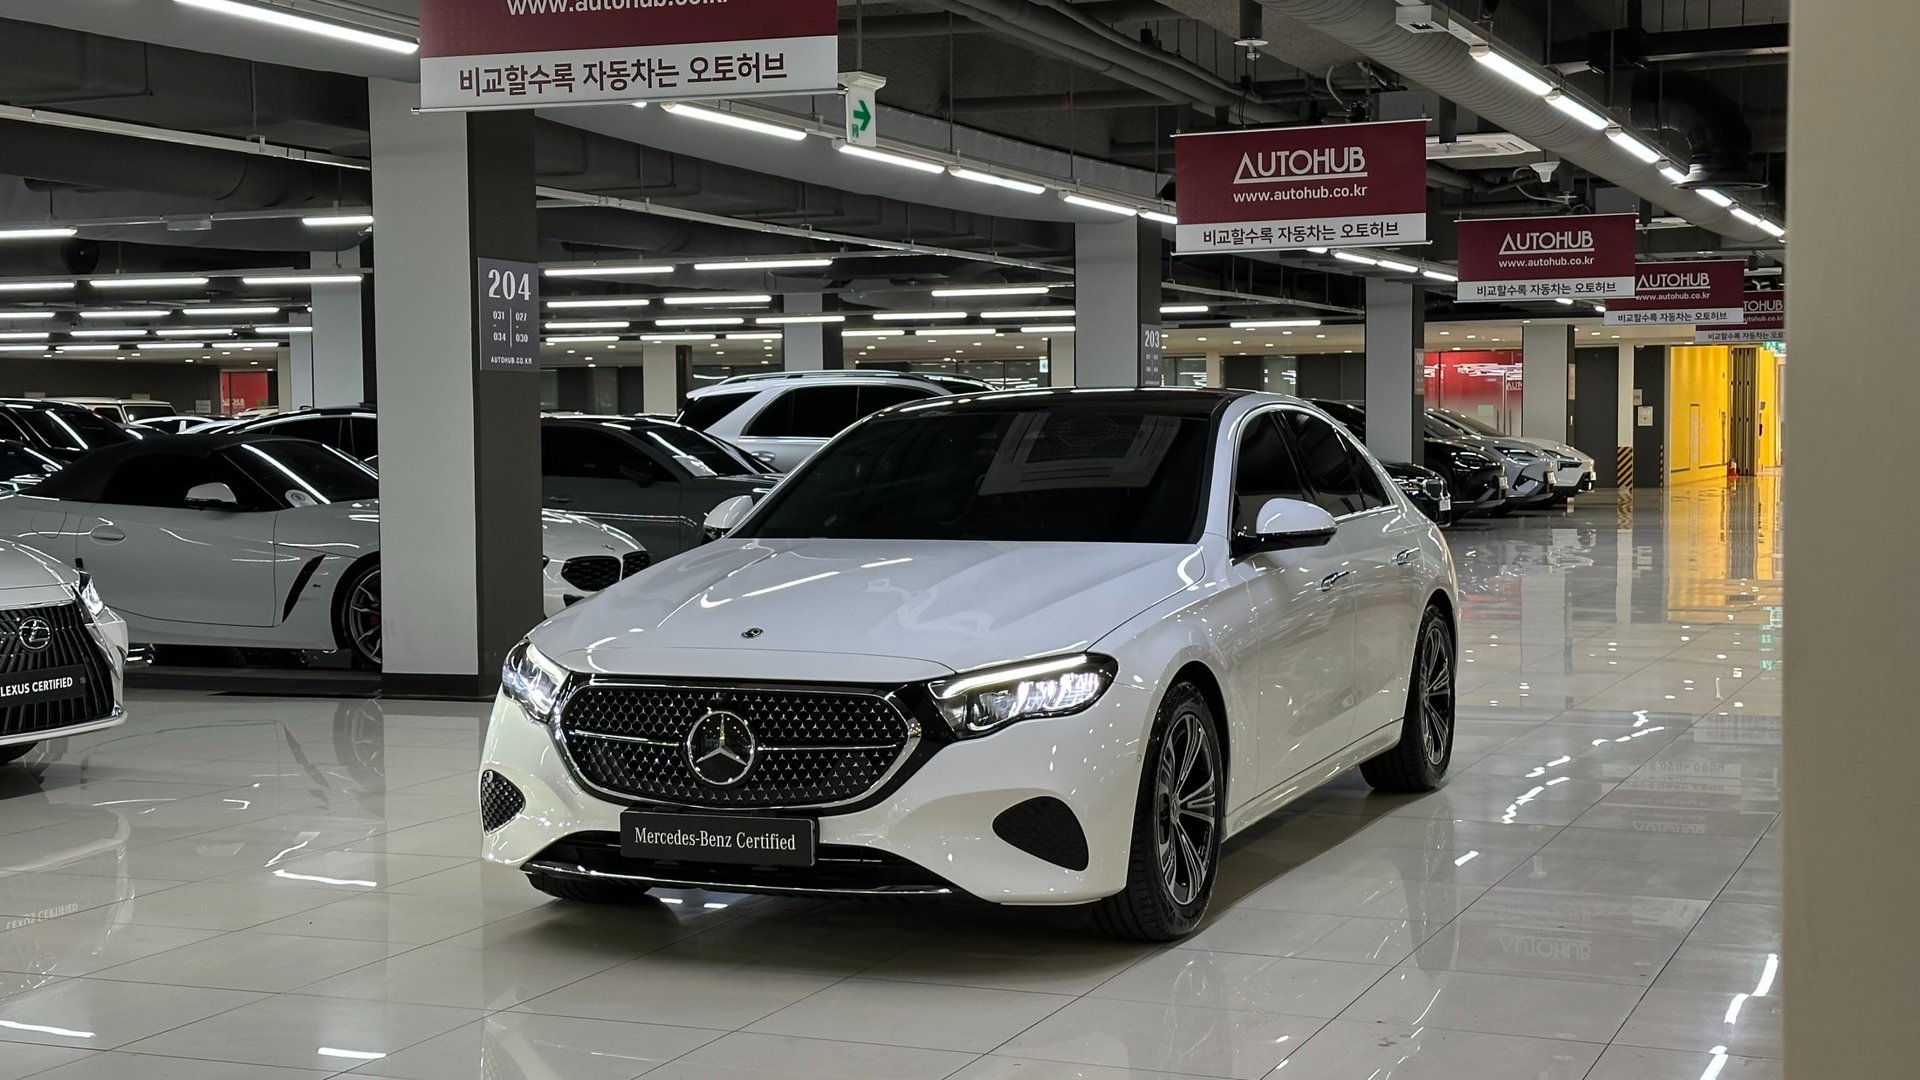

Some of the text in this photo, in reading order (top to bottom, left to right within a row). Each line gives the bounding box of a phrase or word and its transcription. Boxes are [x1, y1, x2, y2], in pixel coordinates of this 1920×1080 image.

[459, 52, 787, 98] 비교할수록 자동차는 오토허브
[1233, 146, 1368, 184] AUTOHUB
[1233, 184, 1368, 203] www.autohub.co.kr
[1203, 221, 1400, 246] 비교할수록 자동차는 오토허브
[1499, 230, 1595, 255] AUTOHUB
[1498, 255, 1595, 268] www.autohub.co.kr
[488, 268, 531, 301] 204
[1477, 281, 1616, 297] 비교할수록 자동차는 오토허브
[1636, 272, 1711, 291] AUTOHUB
[1636, 291, 1711, 301] www.autohub.co.kr
[493, 310, 505, 321] 031
[1743, 300, 1784, 313] TOHUB
[1660, 312, 1693, 322] 자동차는
[1695, 310, 1728, 321] 오토허브
[493, 332, 529, 344] 034 030
[1144, 330, 1160, 348] 203
[1770, 331, 1784, 339] 오토
[0, 677, 73, 697] LEXUS CERTIFIED
[634, 827, 796, 851] Mercedes-Benz Certified
